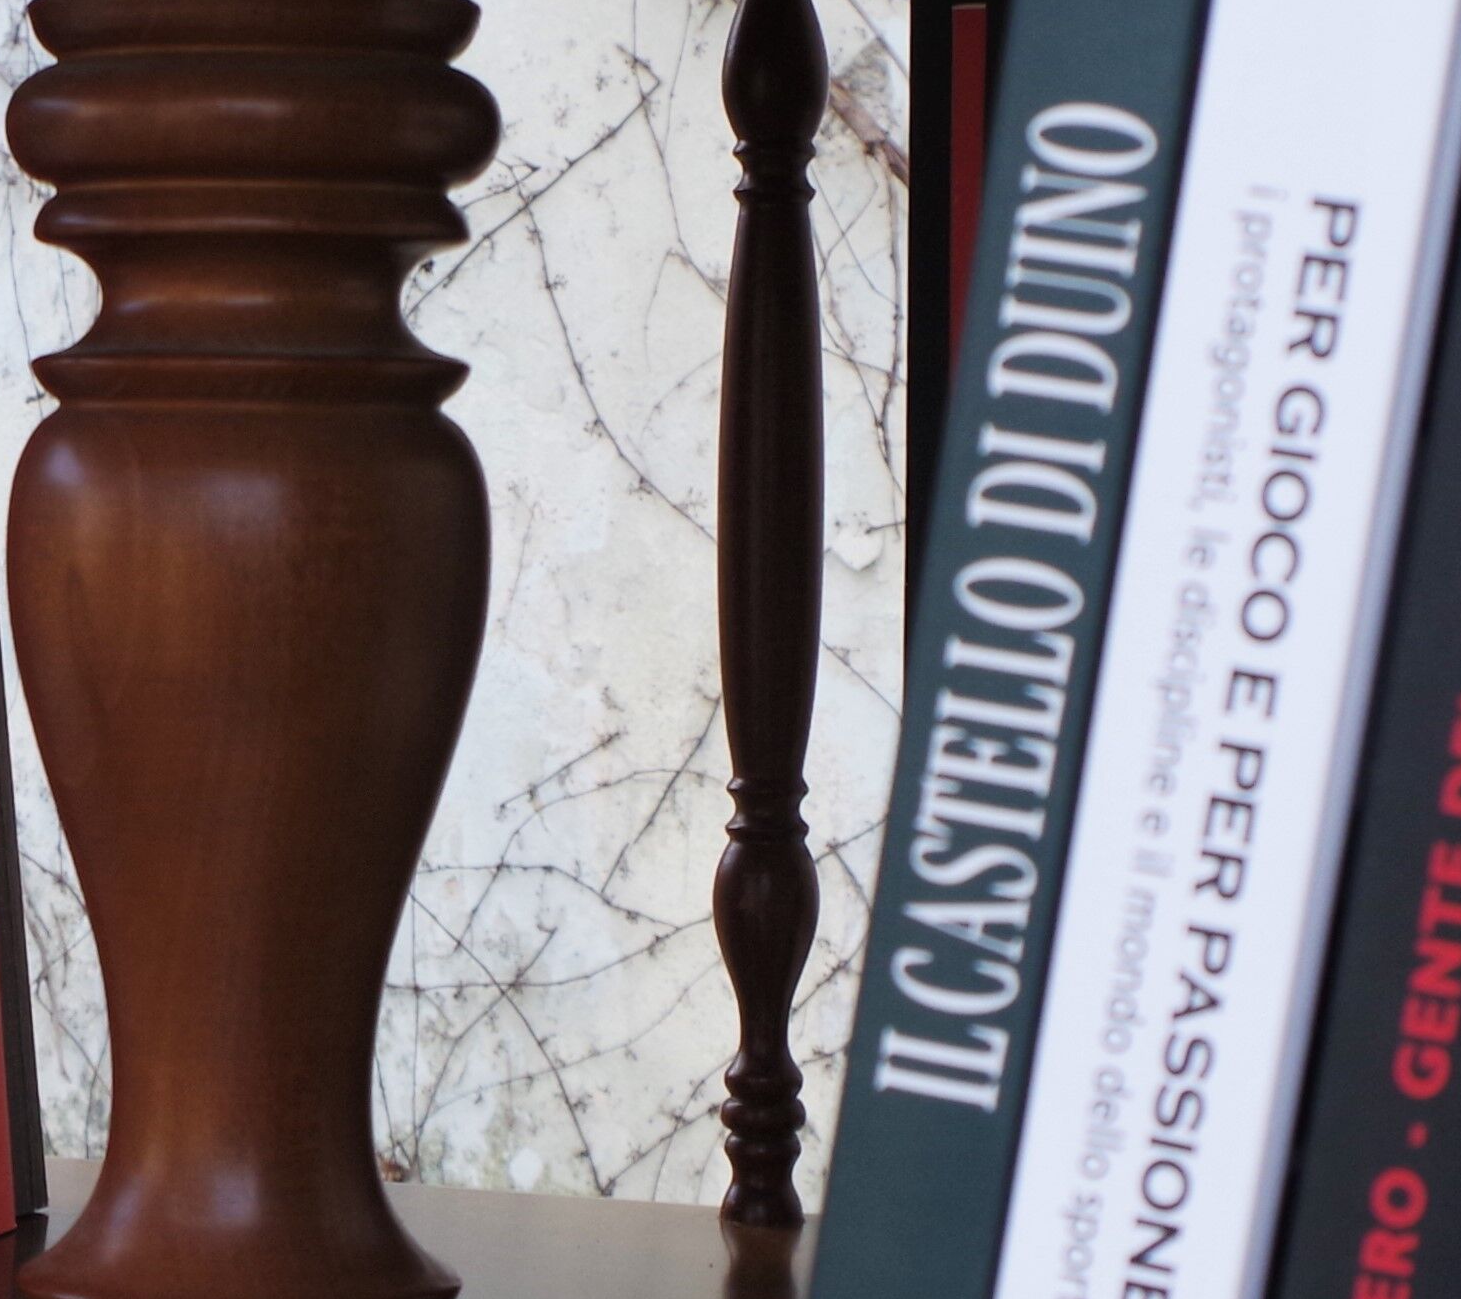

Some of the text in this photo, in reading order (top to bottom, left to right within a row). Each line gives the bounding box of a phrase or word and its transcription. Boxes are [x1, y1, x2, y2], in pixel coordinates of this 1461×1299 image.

[1287, 194, 1360, 362] PER
[1184, 211, 1273, 520] protagonisti,
[1188, 528, 1231, 572] le
[1240, 386, 1329, 647] GIOCO
[874, 103, 1159, 1113] IL CASTELLO DI DUINO
[1148, 586, 1217, 797] discipline
[1224, 668, 1280, 717] E
[1134, 848, 1176, 884] il
[1141, 804, 1170, 834] e
[1191, 740, 1266, 905] PER
[1094, 890, 1156, 1050] mondo
[1081, 1059, 1137, 1182] dello
